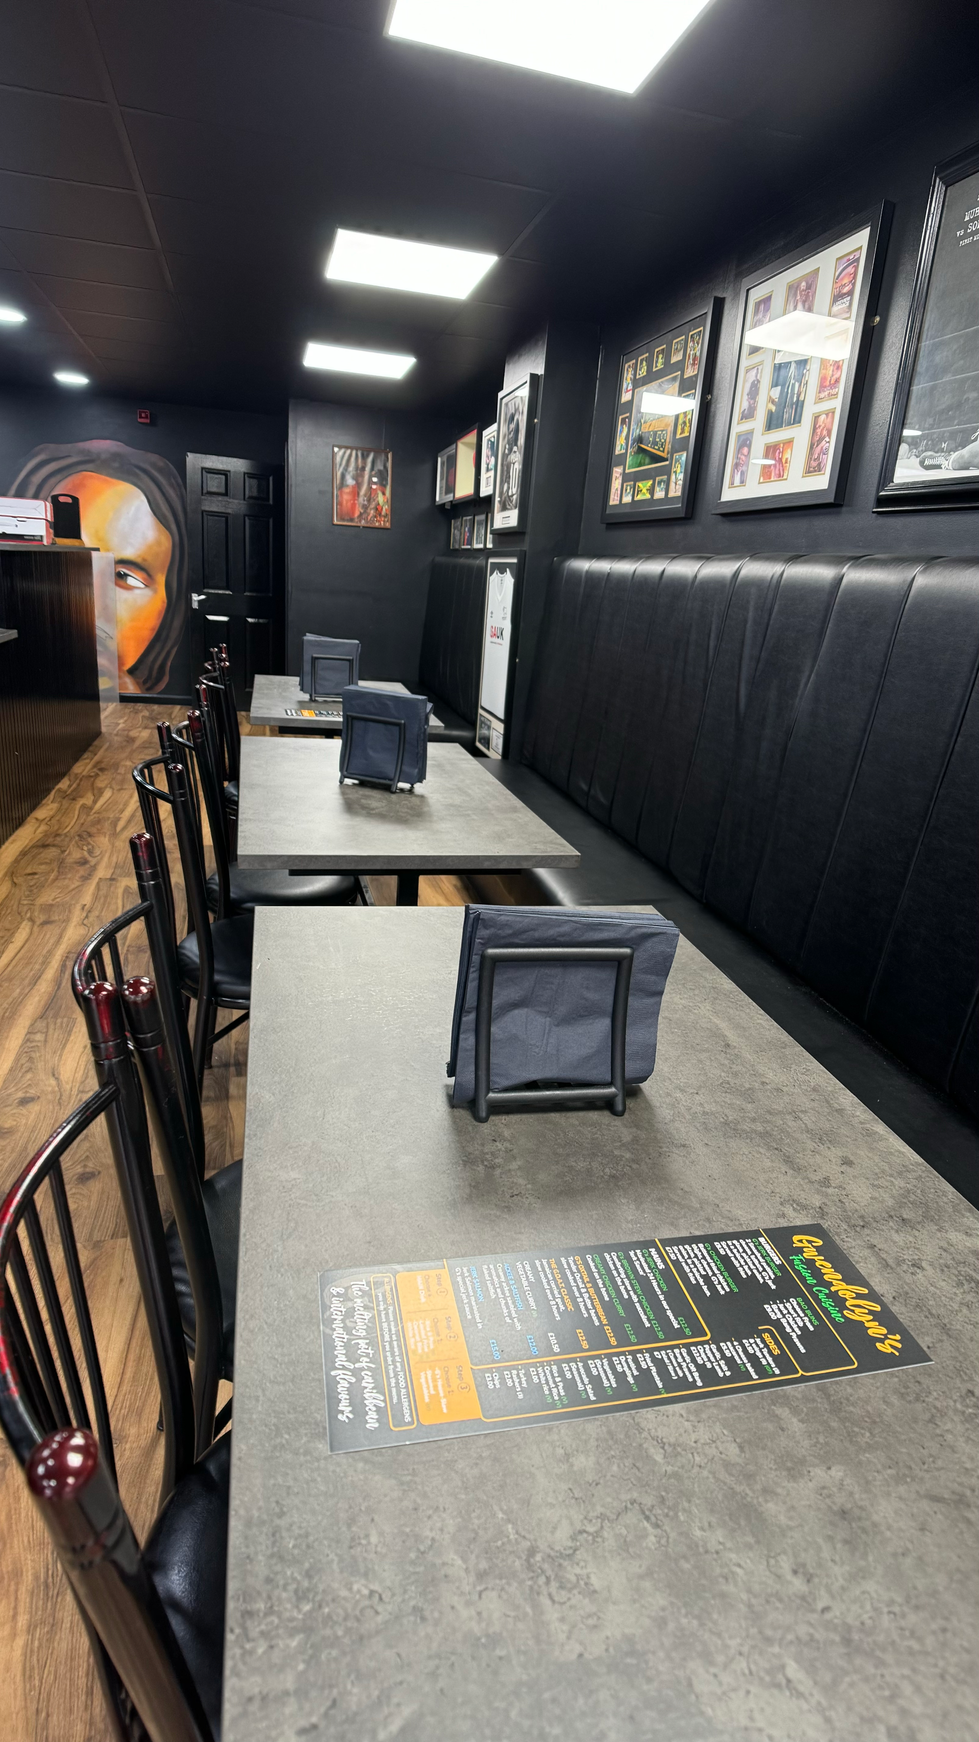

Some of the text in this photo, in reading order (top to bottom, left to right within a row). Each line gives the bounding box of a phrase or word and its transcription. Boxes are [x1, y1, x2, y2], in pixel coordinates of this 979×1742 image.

[648, 1248, 665, 1269] MAINS
[709, 1250, 725, 1271] CHICKEN
[722, 1271, 739, 1292] BURGER
[758, 1237, 782, 1265] BURGERS
[515, 1261, 537, 1310] VEGETABLE CURRY
[534, 1259, 542, 1271] slow
[538, 1271, 550, 1289] cooked
[545, 1288, 553, 1300] over
[551, 1305, 561, 1321] hours
[541, 1258, 561, 1297] Jamaican curried
[560, 1257, 568, 1269] slow
[565, 1268, 577, 1286] cooked
[571, 1286, 580, 1297] over
[578, 1302, 588, 1318] hours
[567, 1256, 577, 1272] Tender
[574, 1272, 585, 1288] Oxtail
[582, 1292, 593, 1309] Butter
[589, 1309, 600, 1326] beans
[585, 1254, 598, 1272] Cooked
[596, 1278, 604, 1288] the
[600, 1287, 609, 1301] bone
[592, 1253, 637, 1343] CREAMY CHICKEN CURRY £12.50
[603, 1252, 615, 1270] chicken
[614, 1276, 622, 1286] the
[619, 1285, 629, 1299] bone
[621, 1259, 635, 1279] BROWN
[631, 1279, 643, 1295] STEW
[639, 1295, 655, 1319] CHICKEN
[650, 1320, 665, 1339] £12.50
[635, 1249, 651, 1273] Marinated
[650, 1279, 661, 1295] Hours
[661, 1300, 670, 1310] our
[666, 1309, 680, 1328] special
[645, 1256, 656, 1268] JERK
[652, 1268, 668, 1291] CHICKEN
[677, 1316, 692, 1335] £12.50
[790, 1254, 845, 1323] Fusion Cuisine
[792, 1235, 902, 1356] Gwendolyn's
[469, 1266, 501, 1360] JERK SALMON £15.00
[503, 1262, 514, 1279] ACKEE
[510, 1284, 524, 1310] SALTFISH
[526, 1335, 538, 1355] £12.00
[522, 1260, 560, 1352] CREAMY £10.50
[549, 1258, 589, 1349] THE CLASSIC £12.50
[578, 1264, 589, 1283] OXTAIL
[587, 1287, 608, 1324] BUTTERBEAN
[603, 1325, 617, 1345] £12.50
[777, 1303, 801, 1335] Jerk Chicken
[784, 1302, 804, 1327] Short Rib
[789, 1297, 814, 1331] Choose From
[796, 1297, 819, 1325] BAO BUNS
[761, 1332, 780, 1355] SIDES
[770, 1304, 806, 1353] Bang Bang Prawns
[330, 1286, 357, 1423] & international flavours
[350, 1279, 385, 1430] The melting pot of caribbean
[518, 1368, 527, 1387] Turkey
[537, 1366, 546, 1384] White
[602, 1358, 617, 1387] Vegetables
[397, 1371, 411, 1422] FOOD ALLERGENS
[492, 1372, 500, 1388] Chips
[510, 1369, 521, 1391] Rashers
[543, 1366, 559, 1400] Coconut Rice
[550, 1364, 558, 1377] Rice
[556, 1381, 565, 1396] Peas
[576, 1361, 596, 1400] Avocado Salad
